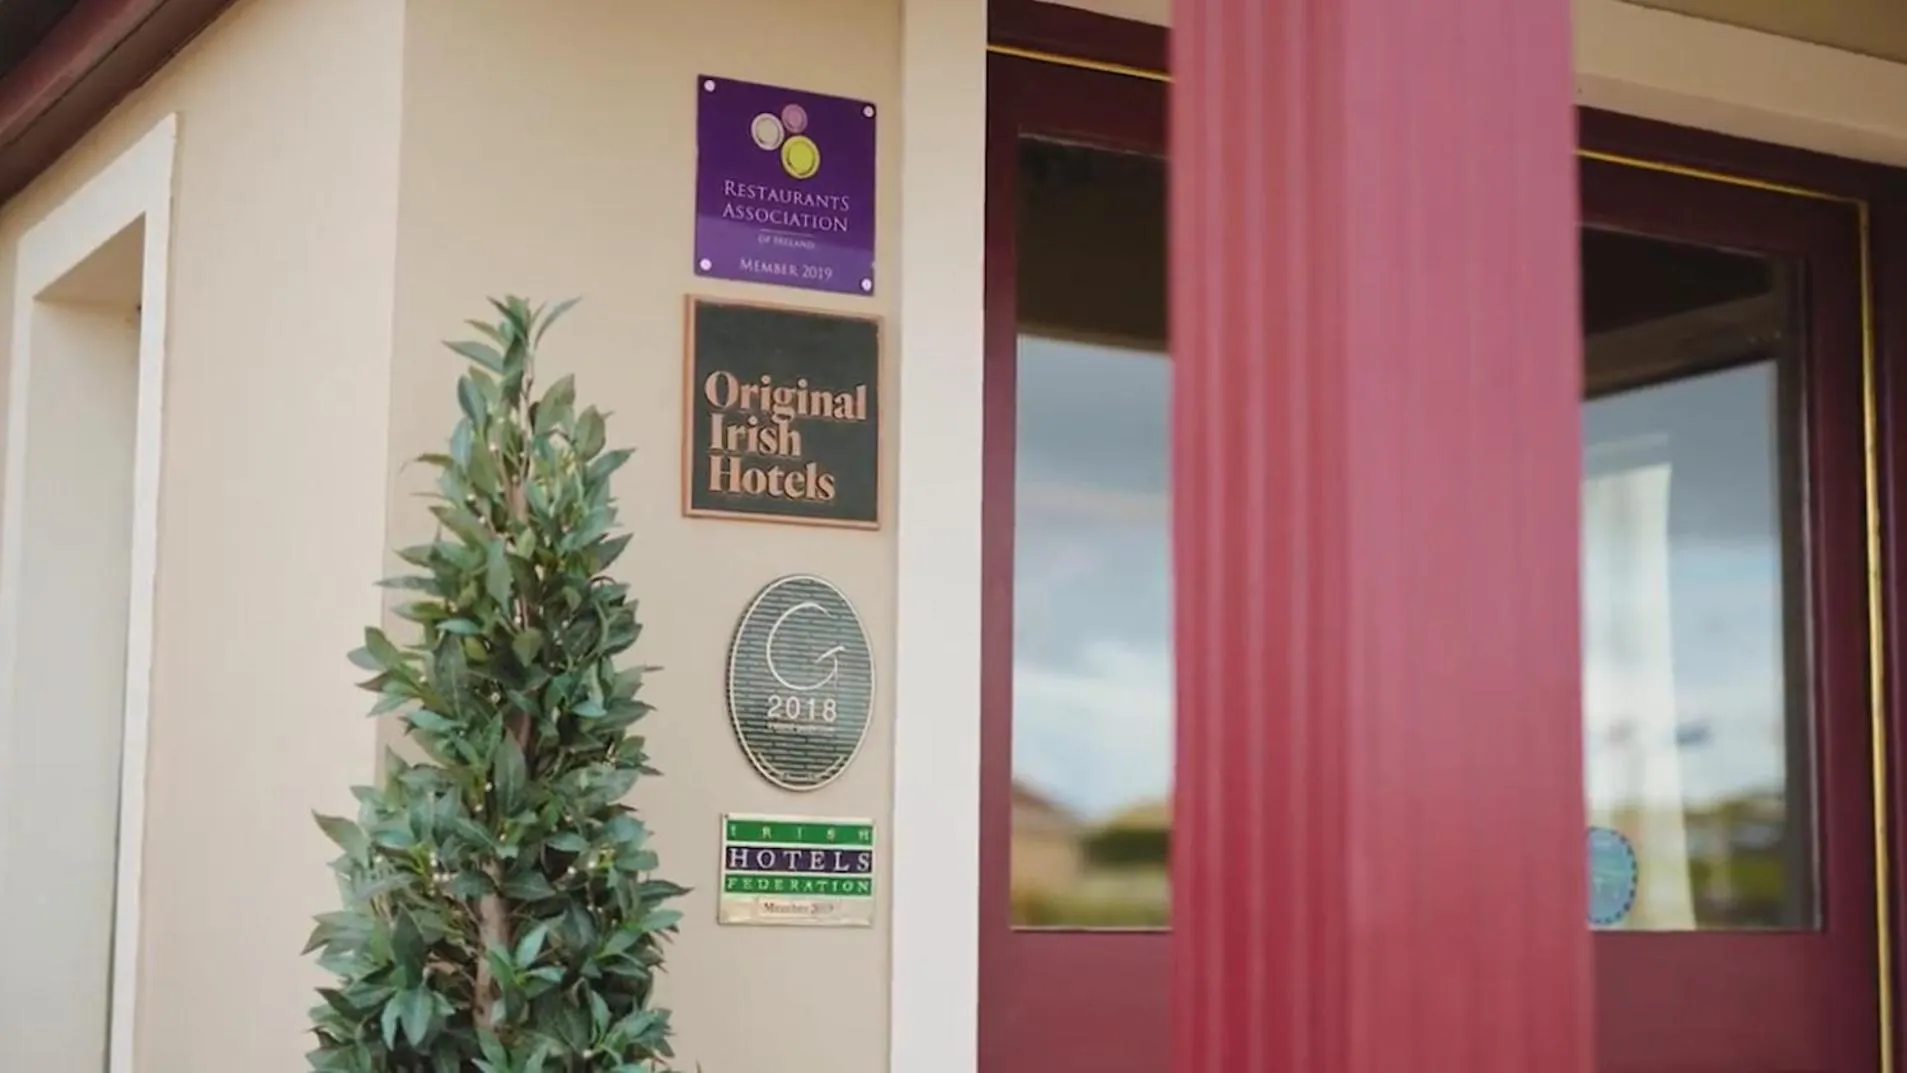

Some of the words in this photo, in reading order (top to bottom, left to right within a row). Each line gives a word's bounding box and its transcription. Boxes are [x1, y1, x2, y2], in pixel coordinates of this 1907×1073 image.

[724, 180, 849, 211] RESTAURANTS
[723, 203, 847, 232] ASSOCIATION
[802, 264, 833, 281] 2019
[704, 370, 867, 424] Original
[710, 413, 801, 456] Irish
[709, 455, 836, 500] Hotels
[767, 695, 837, 722] 2018
[730, 825, 870, 841] IRISH
[729, 848, 870, 872] HOTELS
[728, 878, 869, 893] FEDERATION
